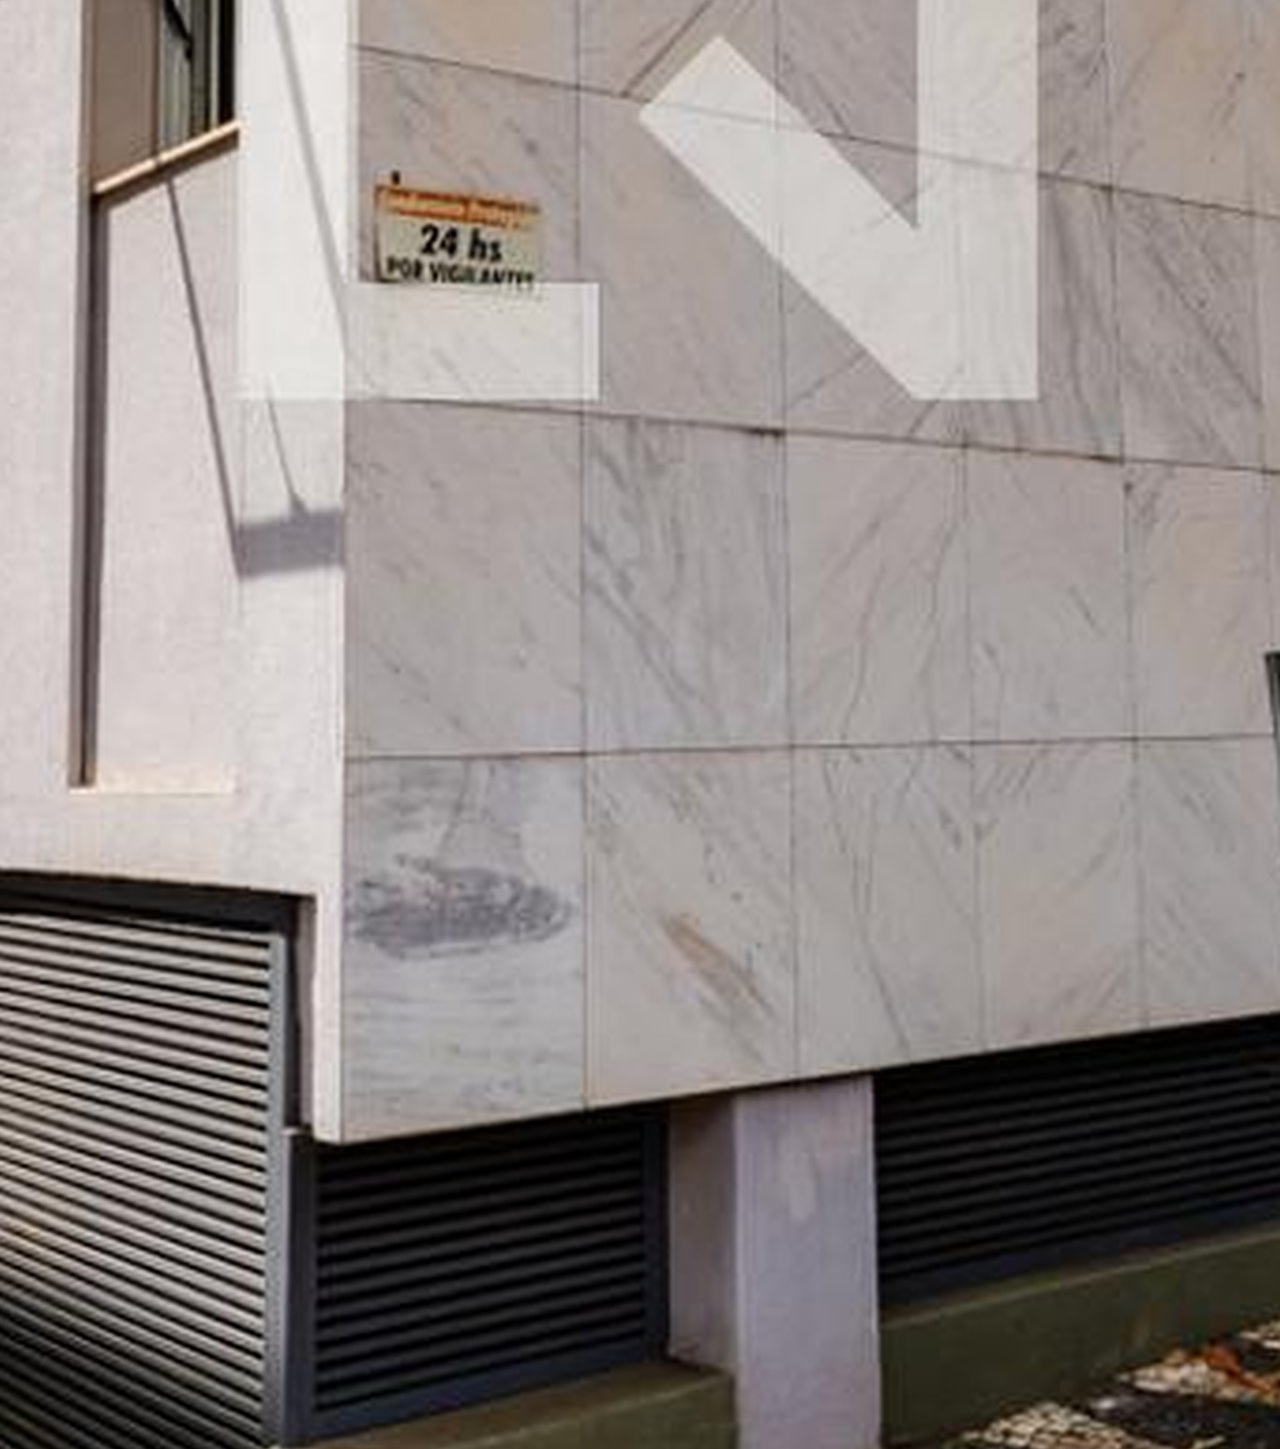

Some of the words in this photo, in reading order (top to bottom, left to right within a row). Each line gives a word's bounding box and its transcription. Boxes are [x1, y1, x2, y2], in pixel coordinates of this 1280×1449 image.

[421, 224, 459, 257] 24
[469, 228, 503, 263] hs
[386, 256, 424, 280] POR
